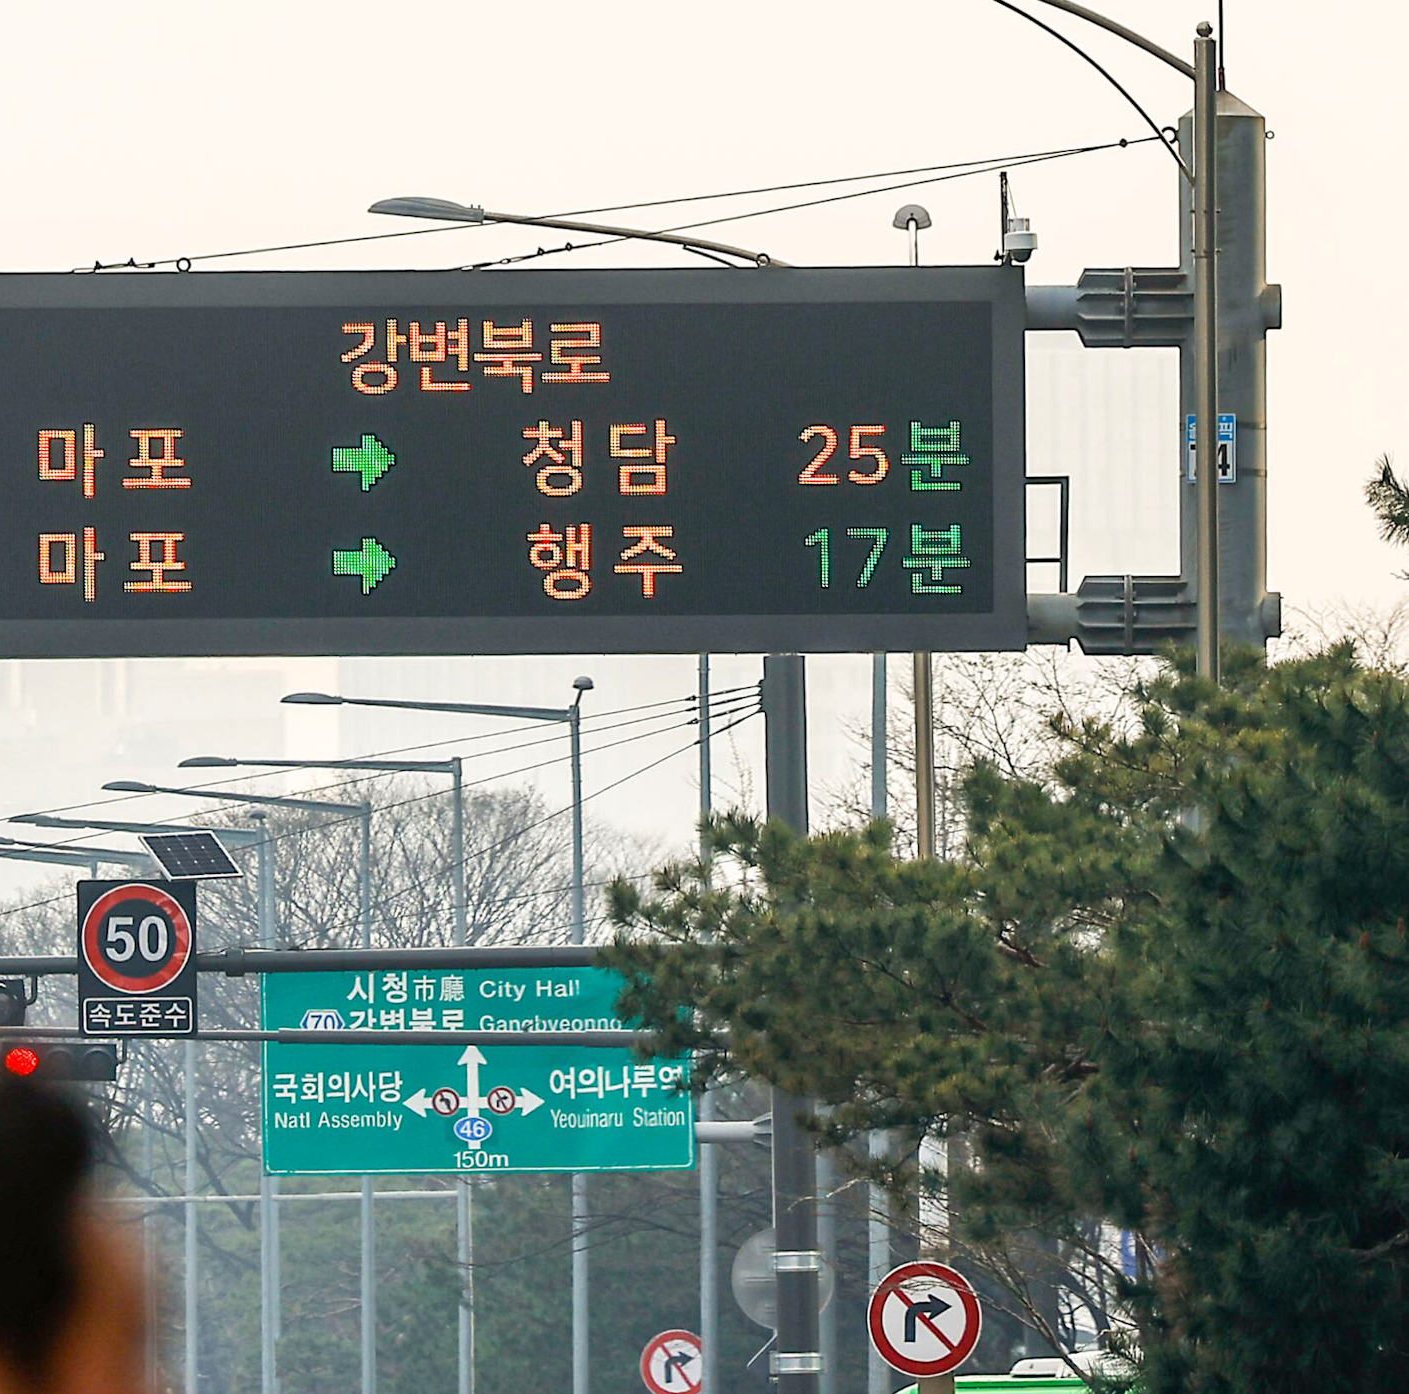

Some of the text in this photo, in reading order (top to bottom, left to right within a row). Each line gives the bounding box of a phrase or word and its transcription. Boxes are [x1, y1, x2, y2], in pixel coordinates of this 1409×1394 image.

[340, 318, 611, 394] 강변북로
[38, 419, 970, 499] 마포 청담 25분
[38, 523, 971, 603] 마포 행주 17분
[105, 915, 169, 962] 50
[479, 979, 526, 1002] City
[536, 979, 581, 999] Hall
[89, 1002, 187, 1029] 속도준수
[312, 1014, 335, 1030] 70
[272, 1070, 404, 1105] 국회의사당
[274, 1110, 403, 1132] Natl Assembly
[459, 1119, 486, 1138] 46
[549, 1106, 685, 1129] Yeouinaru Station
[453, 1150, 510, 1169] 150m
